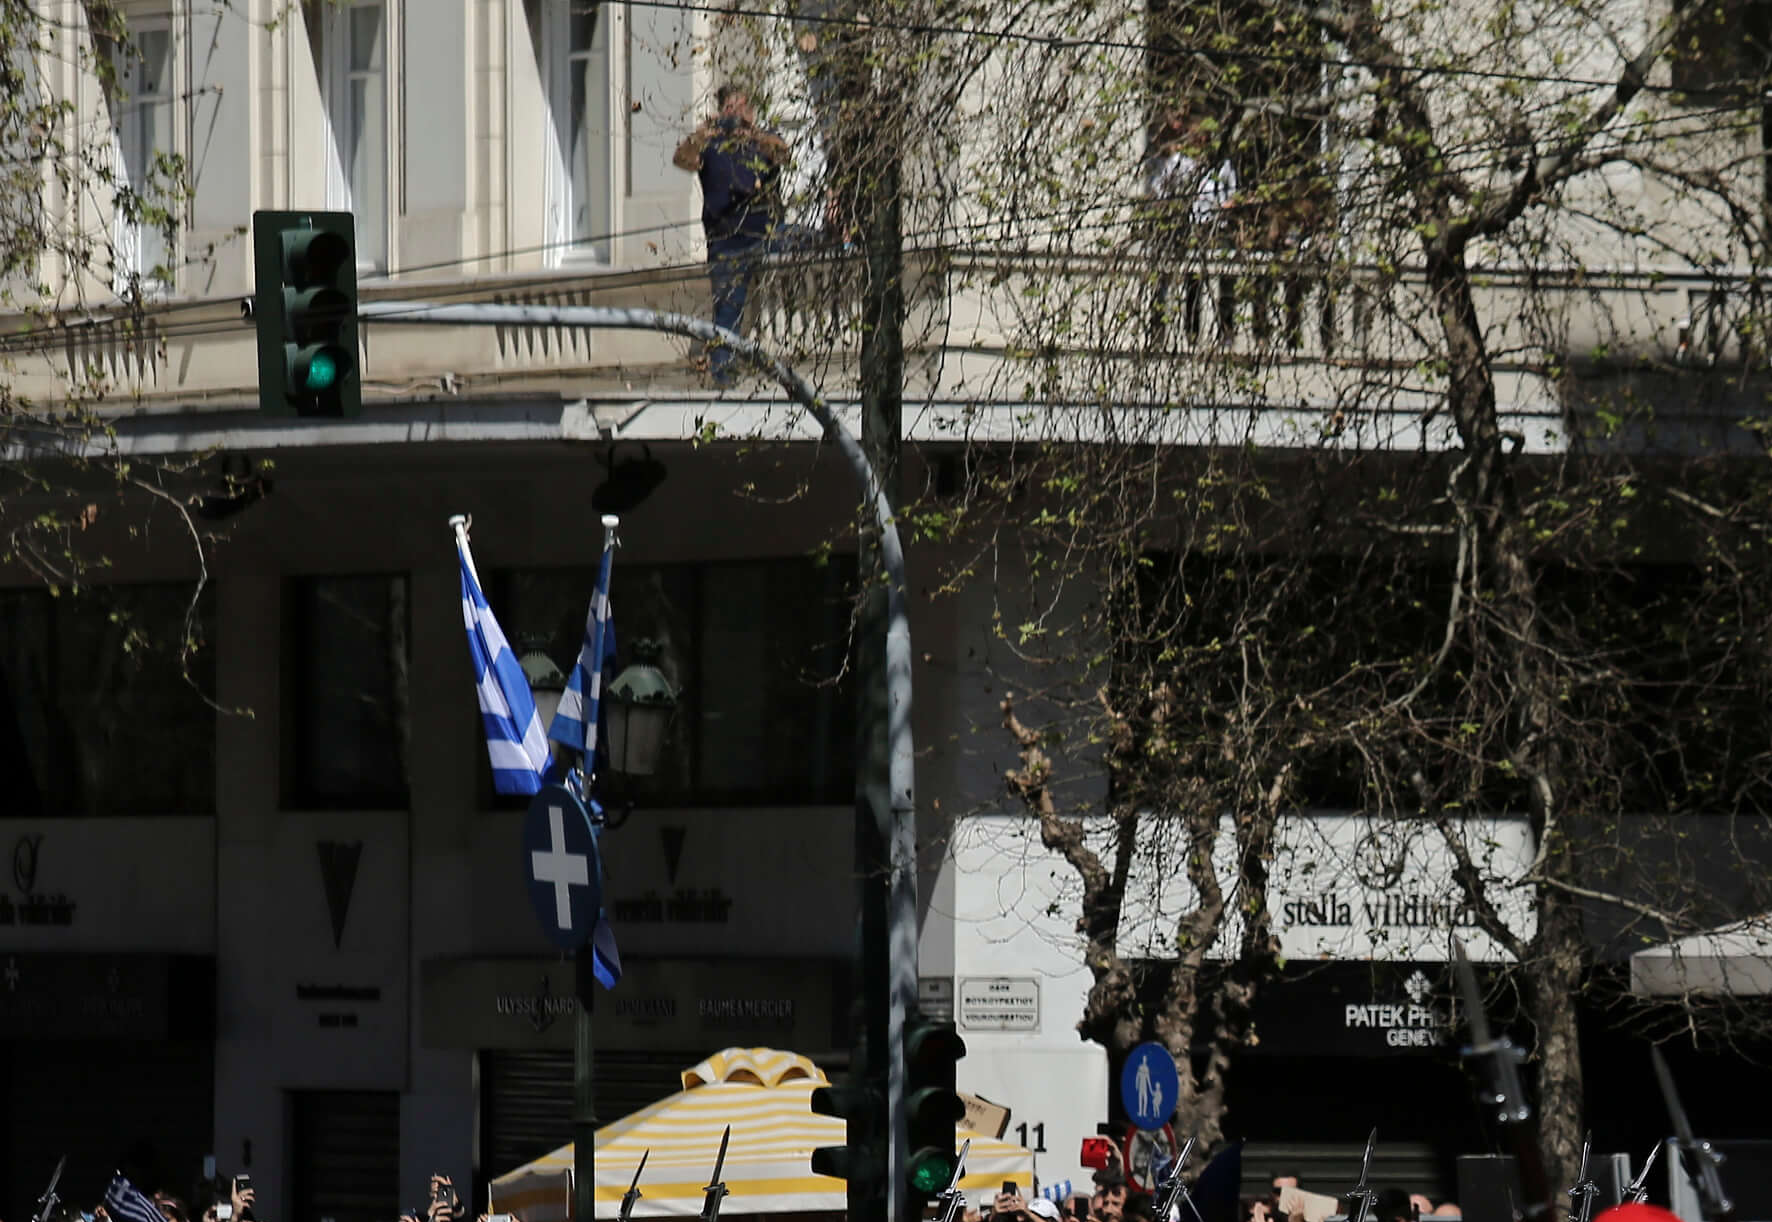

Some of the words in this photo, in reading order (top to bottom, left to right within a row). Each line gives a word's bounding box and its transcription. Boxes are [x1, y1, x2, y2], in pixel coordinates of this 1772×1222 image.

[1283, 893, 1352, 927] stella
[1345, 1003, 1405, 1028] PATEK
[1015, 1122, 1047, 1152] 11
